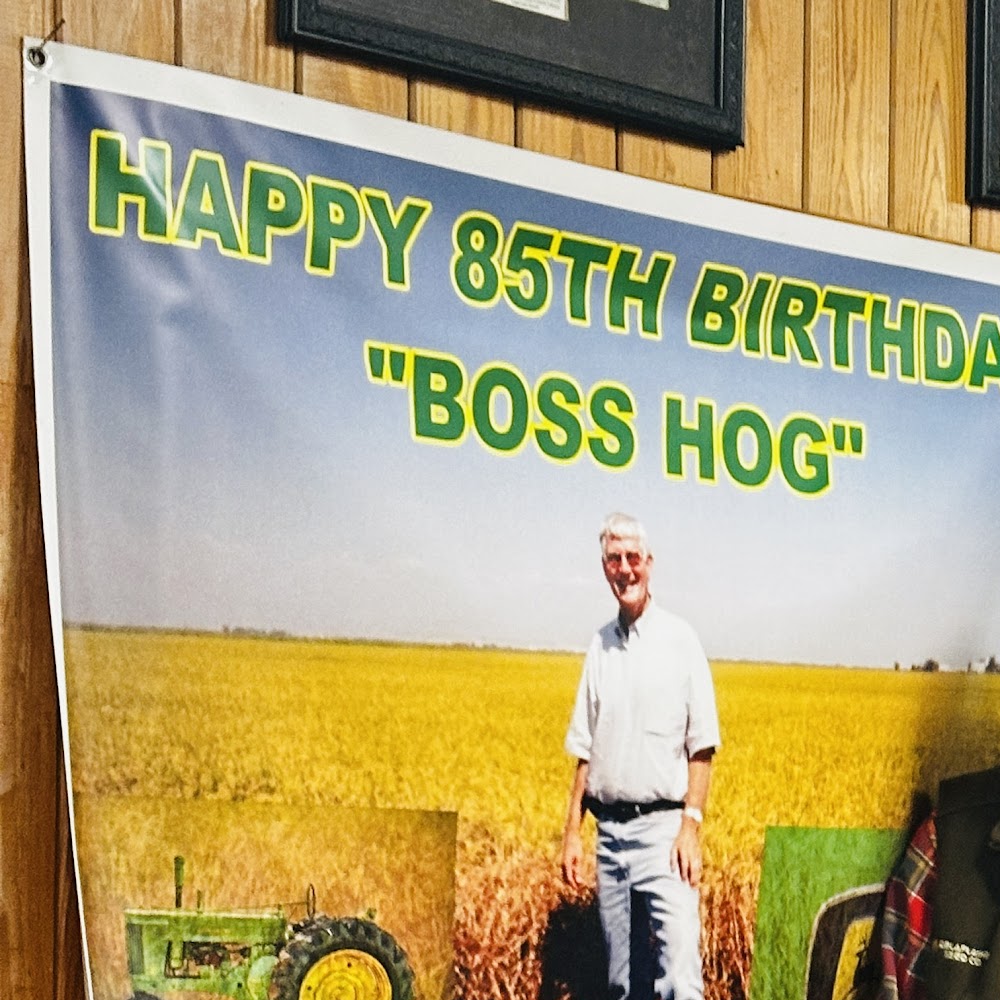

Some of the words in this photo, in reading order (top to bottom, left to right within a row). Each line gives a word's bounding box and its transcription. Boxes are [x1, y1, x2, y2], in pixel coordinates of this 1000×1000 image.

[88, 128, 432, 292] HAPPY
[450, 209, 677, 341] 85TH
[363, 338, 638, 474] "BOSS
[662, 390, 867, 501] HOG"
